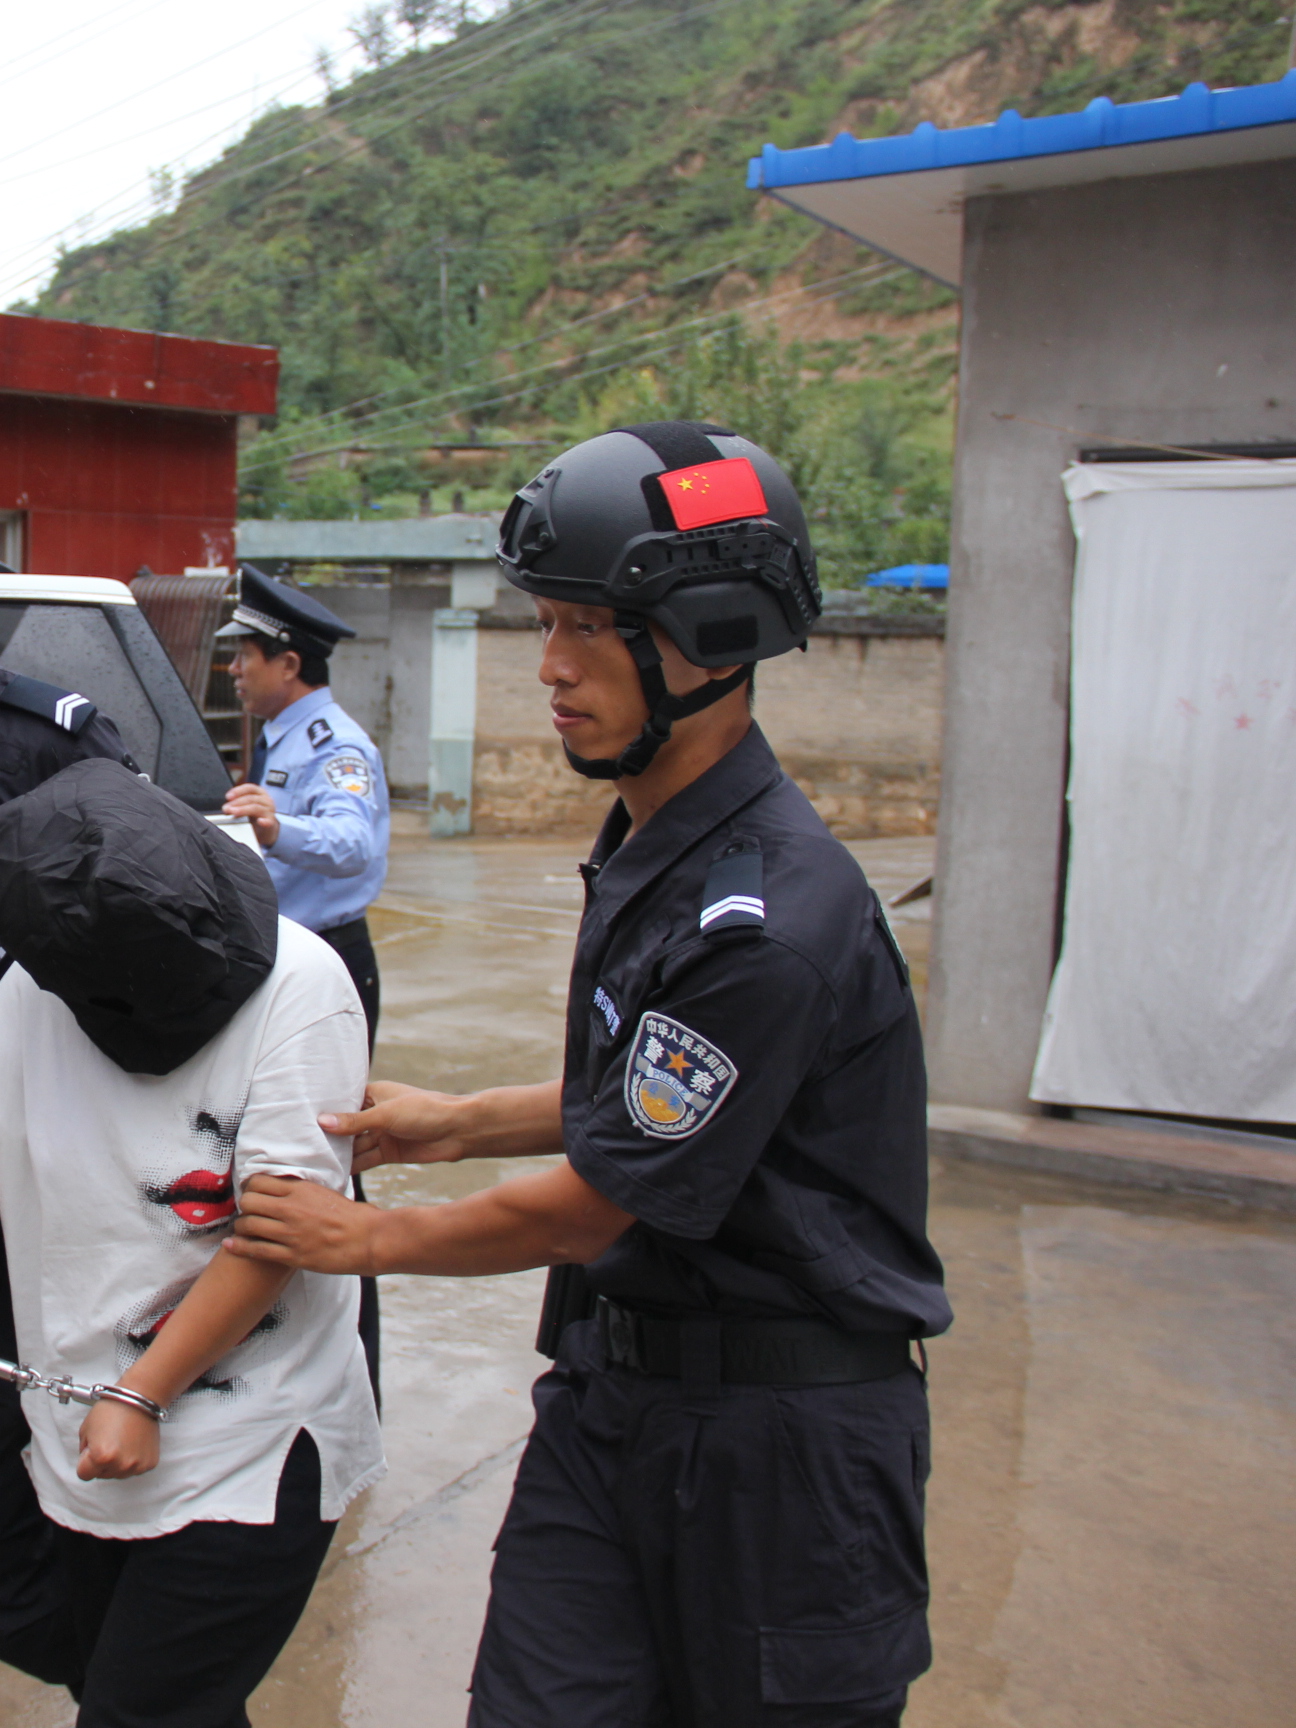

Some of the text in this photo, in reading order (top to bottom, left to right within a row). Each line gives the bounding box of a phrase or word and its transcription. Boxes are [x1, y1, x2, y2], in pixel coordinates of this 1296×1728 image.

[646, 1018, 731, 1082] 中华人民共和国
[652, 1069, 689, 1097] POLICE
